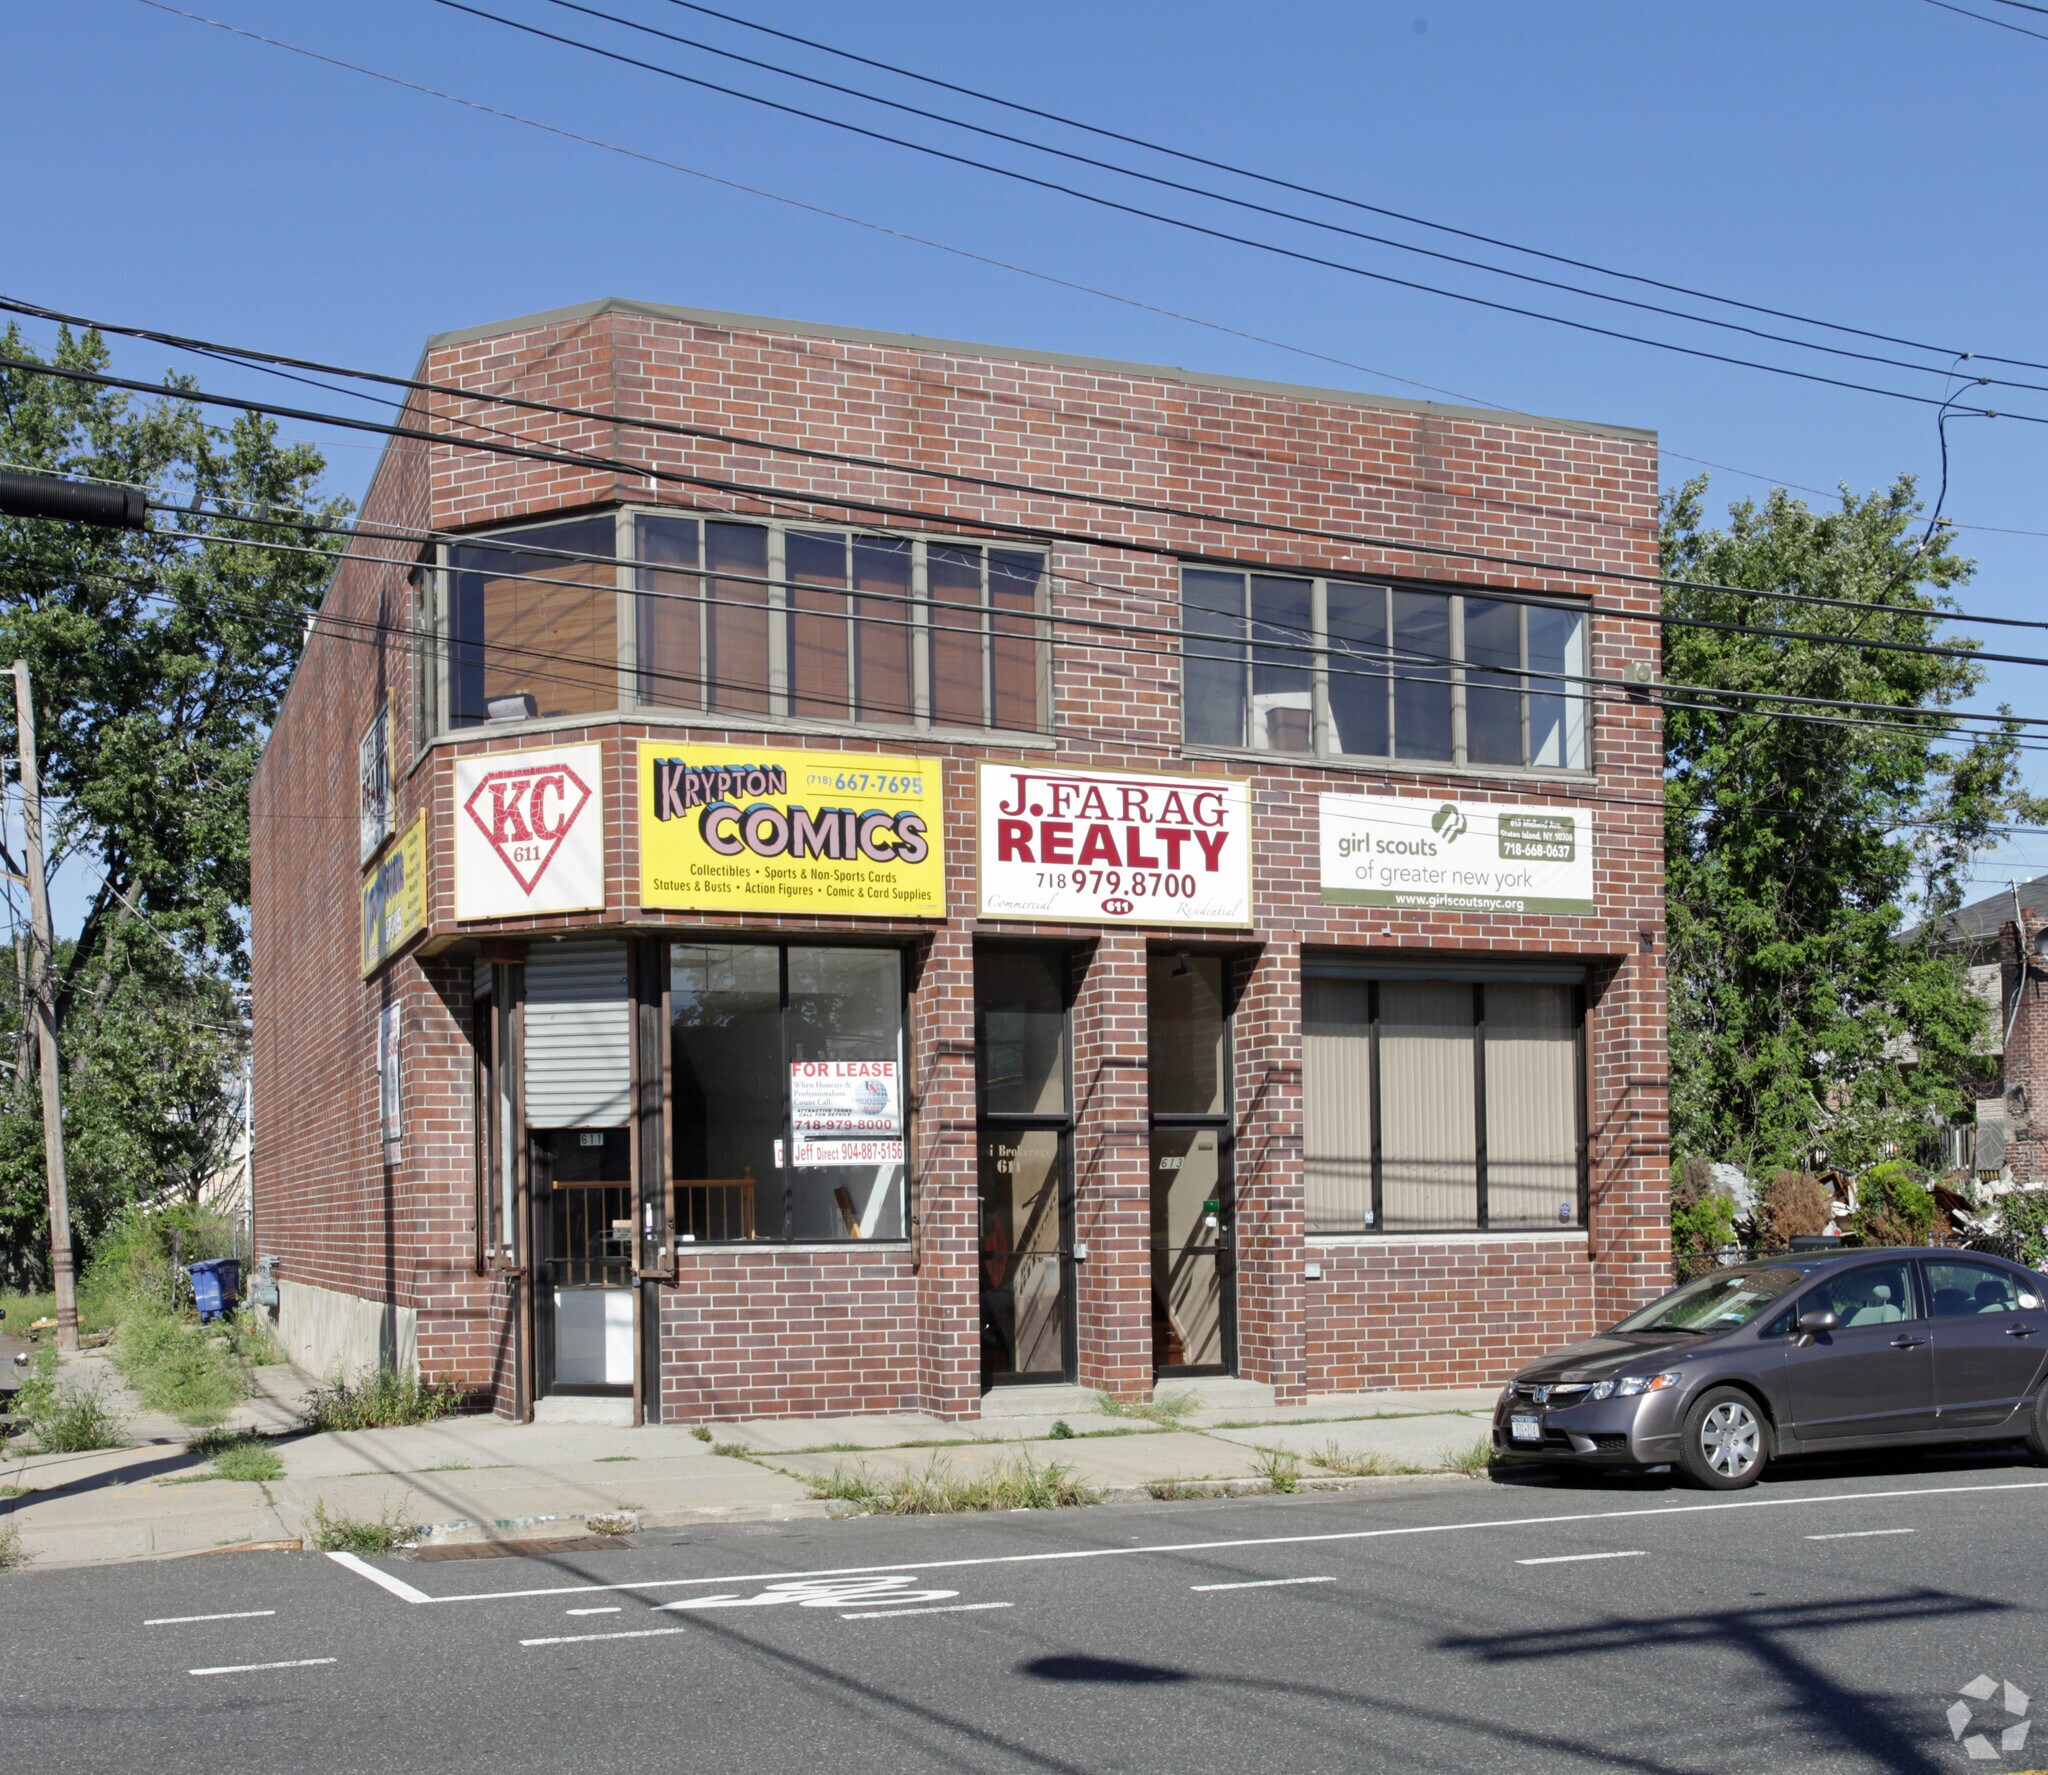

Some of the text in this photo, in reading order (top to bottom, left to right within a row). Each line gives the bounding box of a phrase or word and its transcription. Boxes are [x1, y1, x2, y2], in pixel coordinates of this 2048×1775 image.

[653, 757, 787, 822] KRYPTON
[806, 772, 924, 795] (718) 667-7695
[488, 775, 565, 843] KC
[698, 800, 929, 864] COMICS
[1543, 832, 1553, 841] NY
[1554, 832, 1573, 842] 10306
[513, 845, 541, 863] 611
[998, 818, 1229, 872] REALTY
[1338, 832, 1437, 857] girl scouts
[1503, 842, 1570, 858] 718-668-0637
[690, 863, 897, 884] Collectibles Sports & Non-Sports Cards
[1036, 869, 1196, 898] 718 979.8700
[1355, 859, 1533, 892] of greater new york
[653, 878, 932, 902] Statues & Busts Action Figures Comic & Card Supplies
[987, 891, 1243, 917] Commercial 611 Residential
[1395, 893, 1524, 911] www.girlscoutsnyc.org
[792, 1062, 893, 1077] FOR LEASE
[793, 1081, 814, 1089] When
[795, 1120, 892, 1130] 718-979-8000
[581, 1134, 602, 1145] 611
[795, 1144, 813, 1161] Jeff
[817, 1147, 839, 1160] Direct
[841, 1142, 902, 1160] 904-887-5156
[1161, 1158, 1183, 1168] 613
